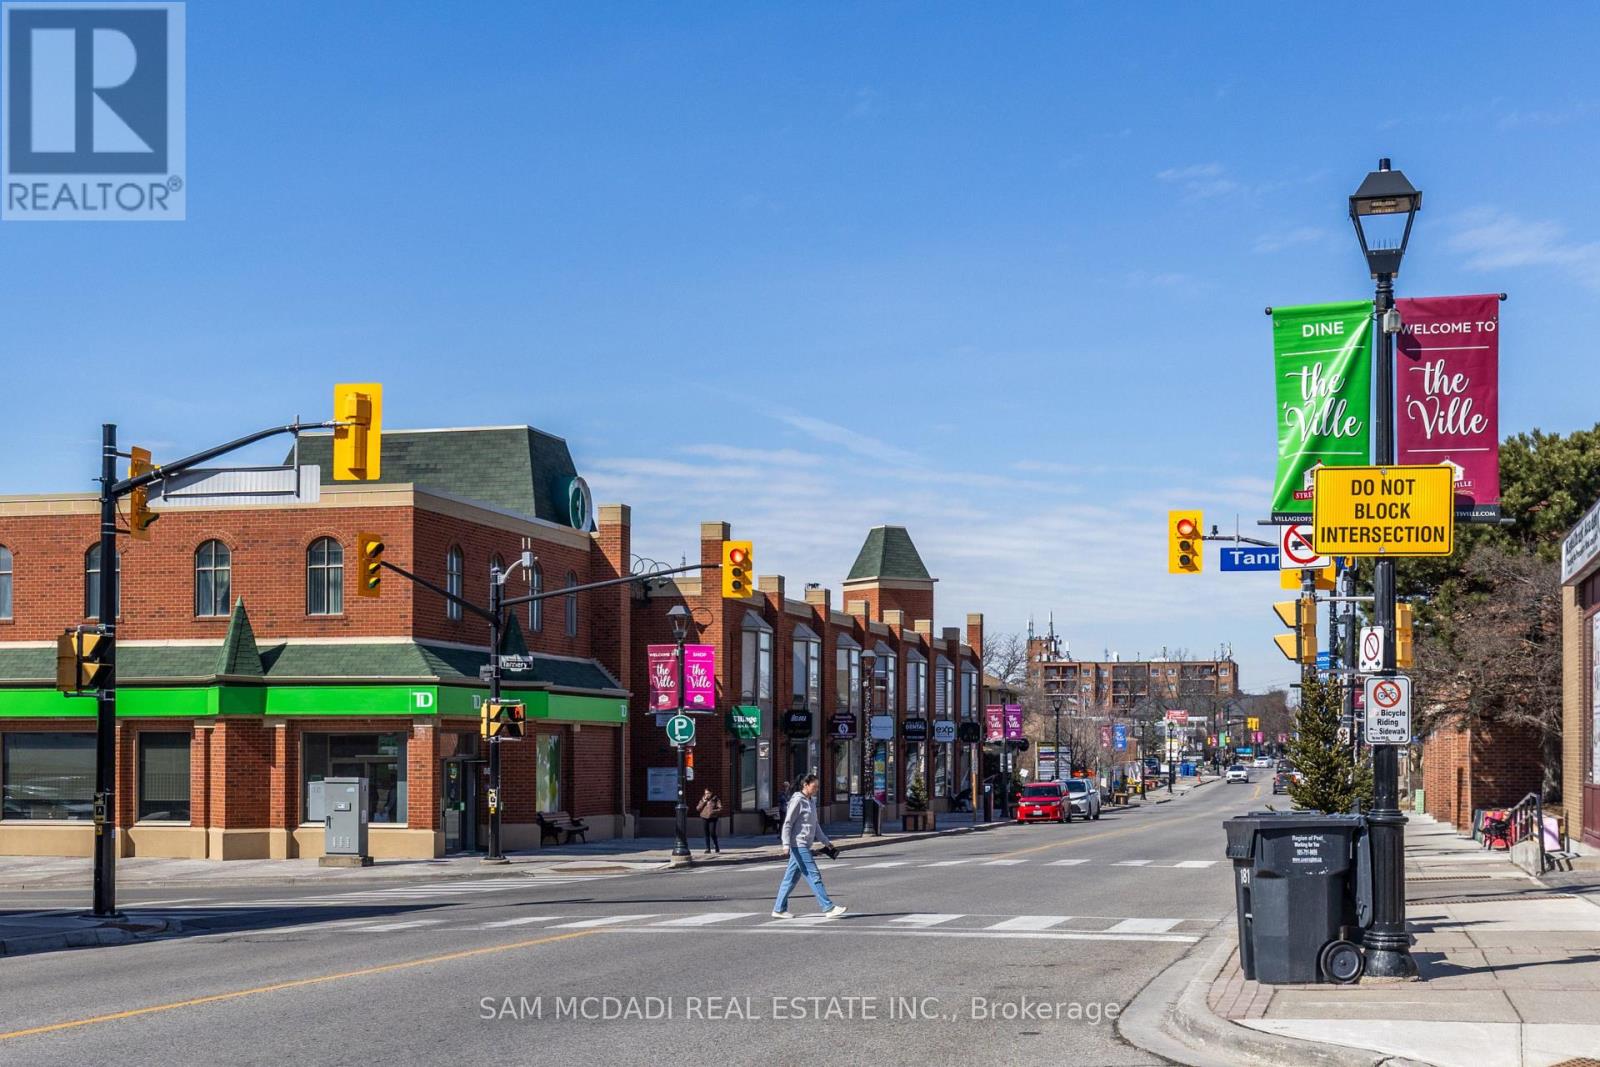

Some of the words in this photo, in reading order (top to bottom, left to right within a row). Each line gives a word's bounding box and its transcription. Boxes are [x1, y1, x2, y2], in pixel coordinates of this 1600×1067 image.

[1302, 321, 1345, 338] DINE
[1400, 322, 1472, 335] WELCOME
[1476, 321, 1496, 333] TO
[1285, 362, 1346, 401] the
[1409, 359, 1470, 395] the
[1295, 490, 1314, 500] STRE
[1351, 479, 1375, 496] DO
[1381, 479, 1416, 496] NOT
[1354, 503, 1411, 519] BLOCK
[1320, 525, 1445, 543] INTERSECTION
[1229, 550, 1280, 566] Tann
[652, 663, 671, 676] the
[688, 663, 708, 676] the
[412, 692, 433, 708] TD
[1380, 709, 1407, 719] Bicycle
[674, 718, 688, 735] P
[936, 726, 954, 736] exp
[1377, 718, 1399, 728] Riding
[1379, 727, 1406, 735] Sidewalk
